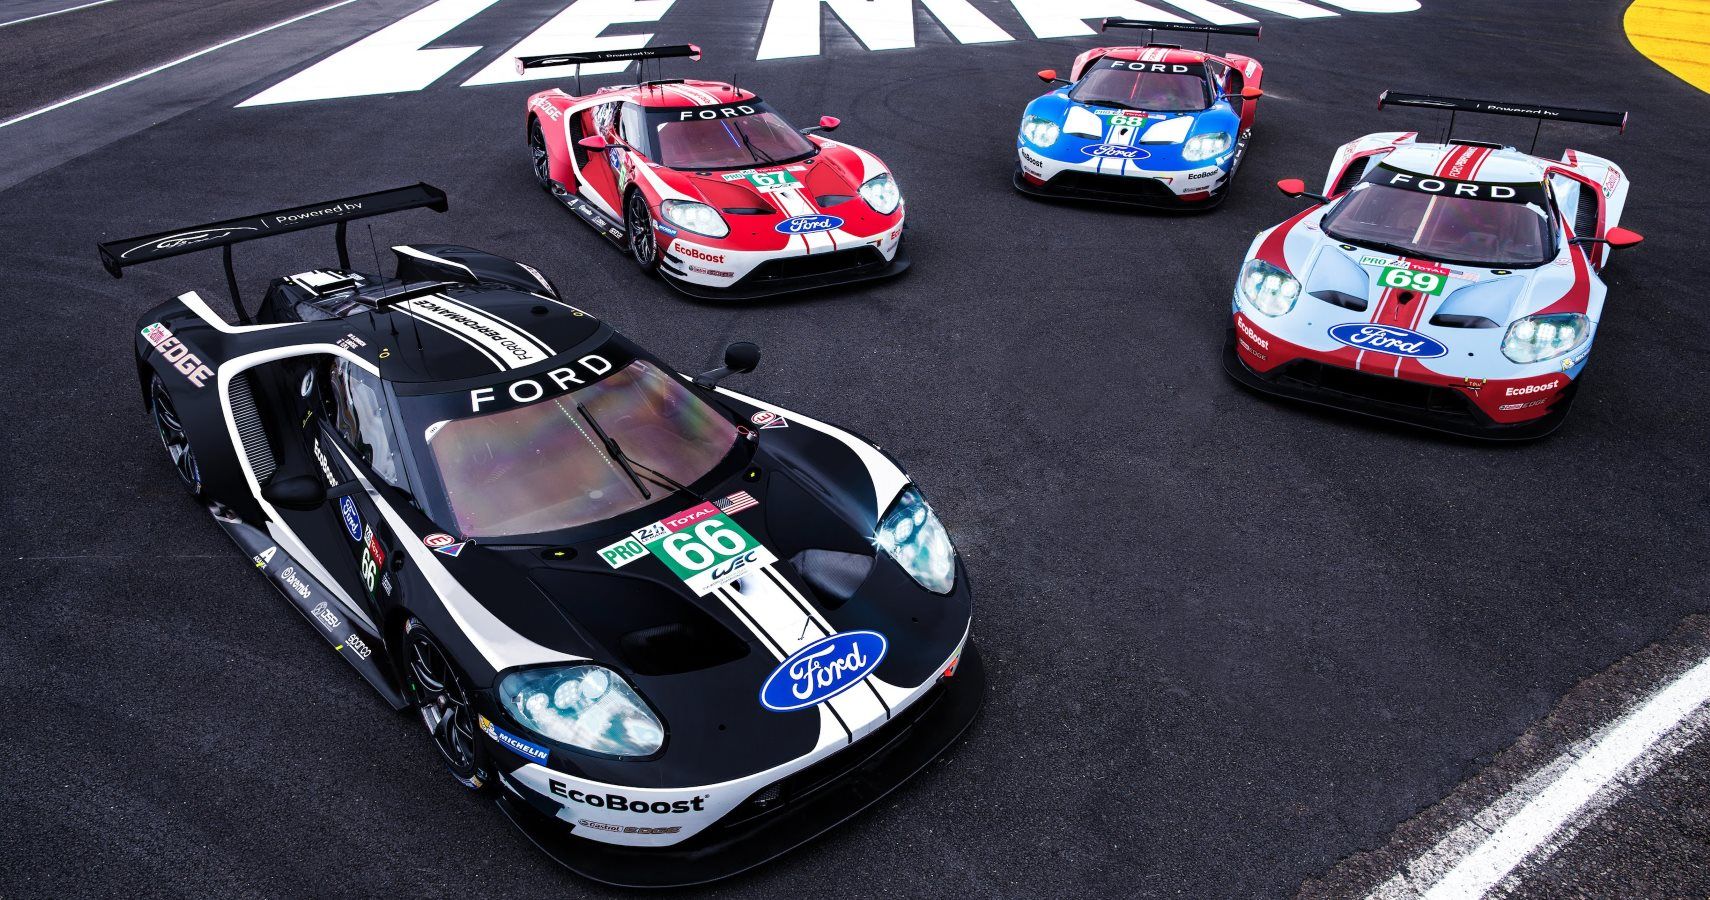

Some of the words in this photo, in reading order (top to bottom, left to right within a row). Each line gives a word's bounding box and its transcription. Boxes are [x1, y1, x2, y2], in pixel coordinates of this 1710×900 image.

[1110, 60, 1189, 73] FORD
[680, 105, 755, 121] FORD
[1110, 115, 1143, 127] 68
[1487, 104, 1542, 115] Powered
[1093, 145, 1139, 158] Ford
[751, 170, 787, 186] 67
[1389, 173, 1516, 199] FORD
[275, 203, 344, 226] Powered
[790, 216, 832, 232] Ford
[674, 242, 725, 264] EcoBoost
[1361, 257, 1387, 266] PRO
[1411, 264, 1447, 275] TOTAL
[1385, 268, 1440, 293] 69
[413, 299, 506, 343] PERFORMANCE
[1237, 315, 1269, 351] EcoBoost
[500, 340, 534, 361] FORD
[1350, 326, 1425, 353] Ford
[155, 336, 216, 389] EDGE
[469, 354, 613, 413] FORD
[1505, 379, 1560, 397] EcoBoost
[343, 497, 358, 536] Ford
[666, 507, 715, 528] TOTAL
[602, 540, 644, 566] PRO
[662, 519, 747, 571] 66
[361, 546, 377, 593] 66
[711, 550, 758, 581] WEC
[347, 633, 372, 658] sparco
[789, 641, 867, 700] Ford
[499, 732, 548, 760] MICHELIN
[588, 821, 622, 833] Castrol
